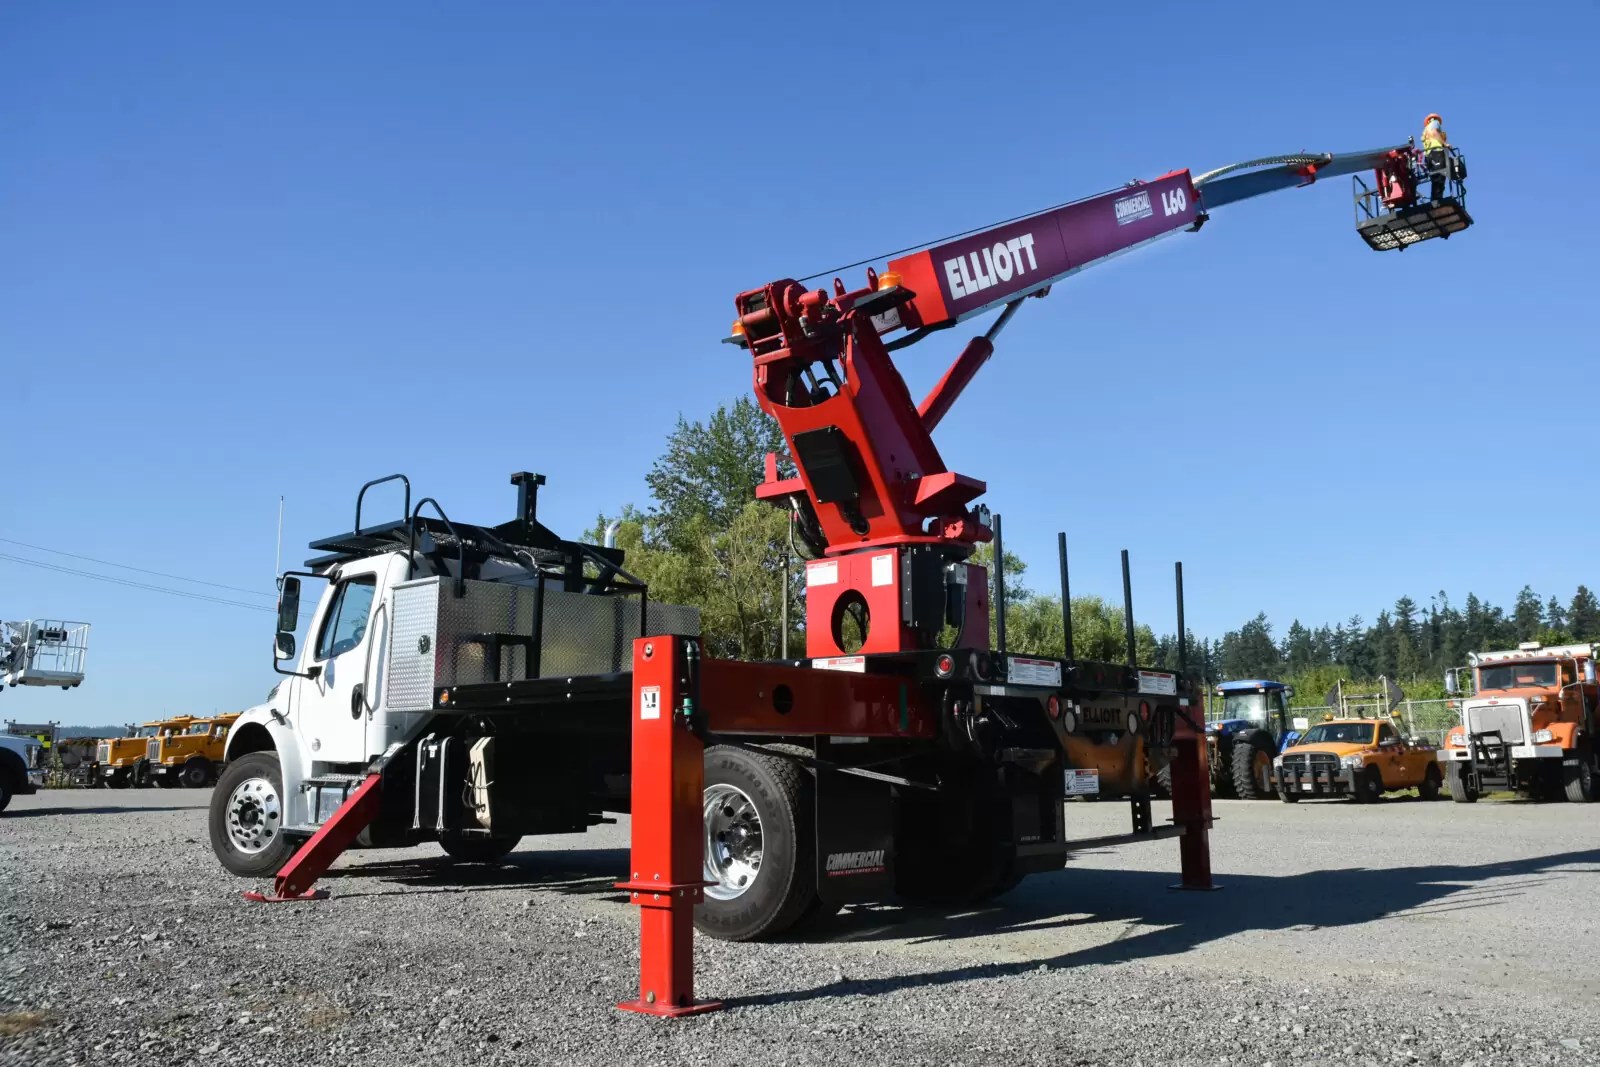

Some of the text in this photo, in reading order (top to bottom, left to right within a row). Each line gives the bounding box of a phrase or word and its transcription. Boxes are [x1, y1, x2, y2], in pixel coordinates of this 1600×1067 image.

[1115, 194, 1150, 219] COMMERCIAL
[1161, 187, 1187, 217] L60
[943, 232, 1038, 301] ELLIOTT
[1082, 706, 1121, 725] ELLIOTT
[826, 850, 885, 871] COMMERCIAL
